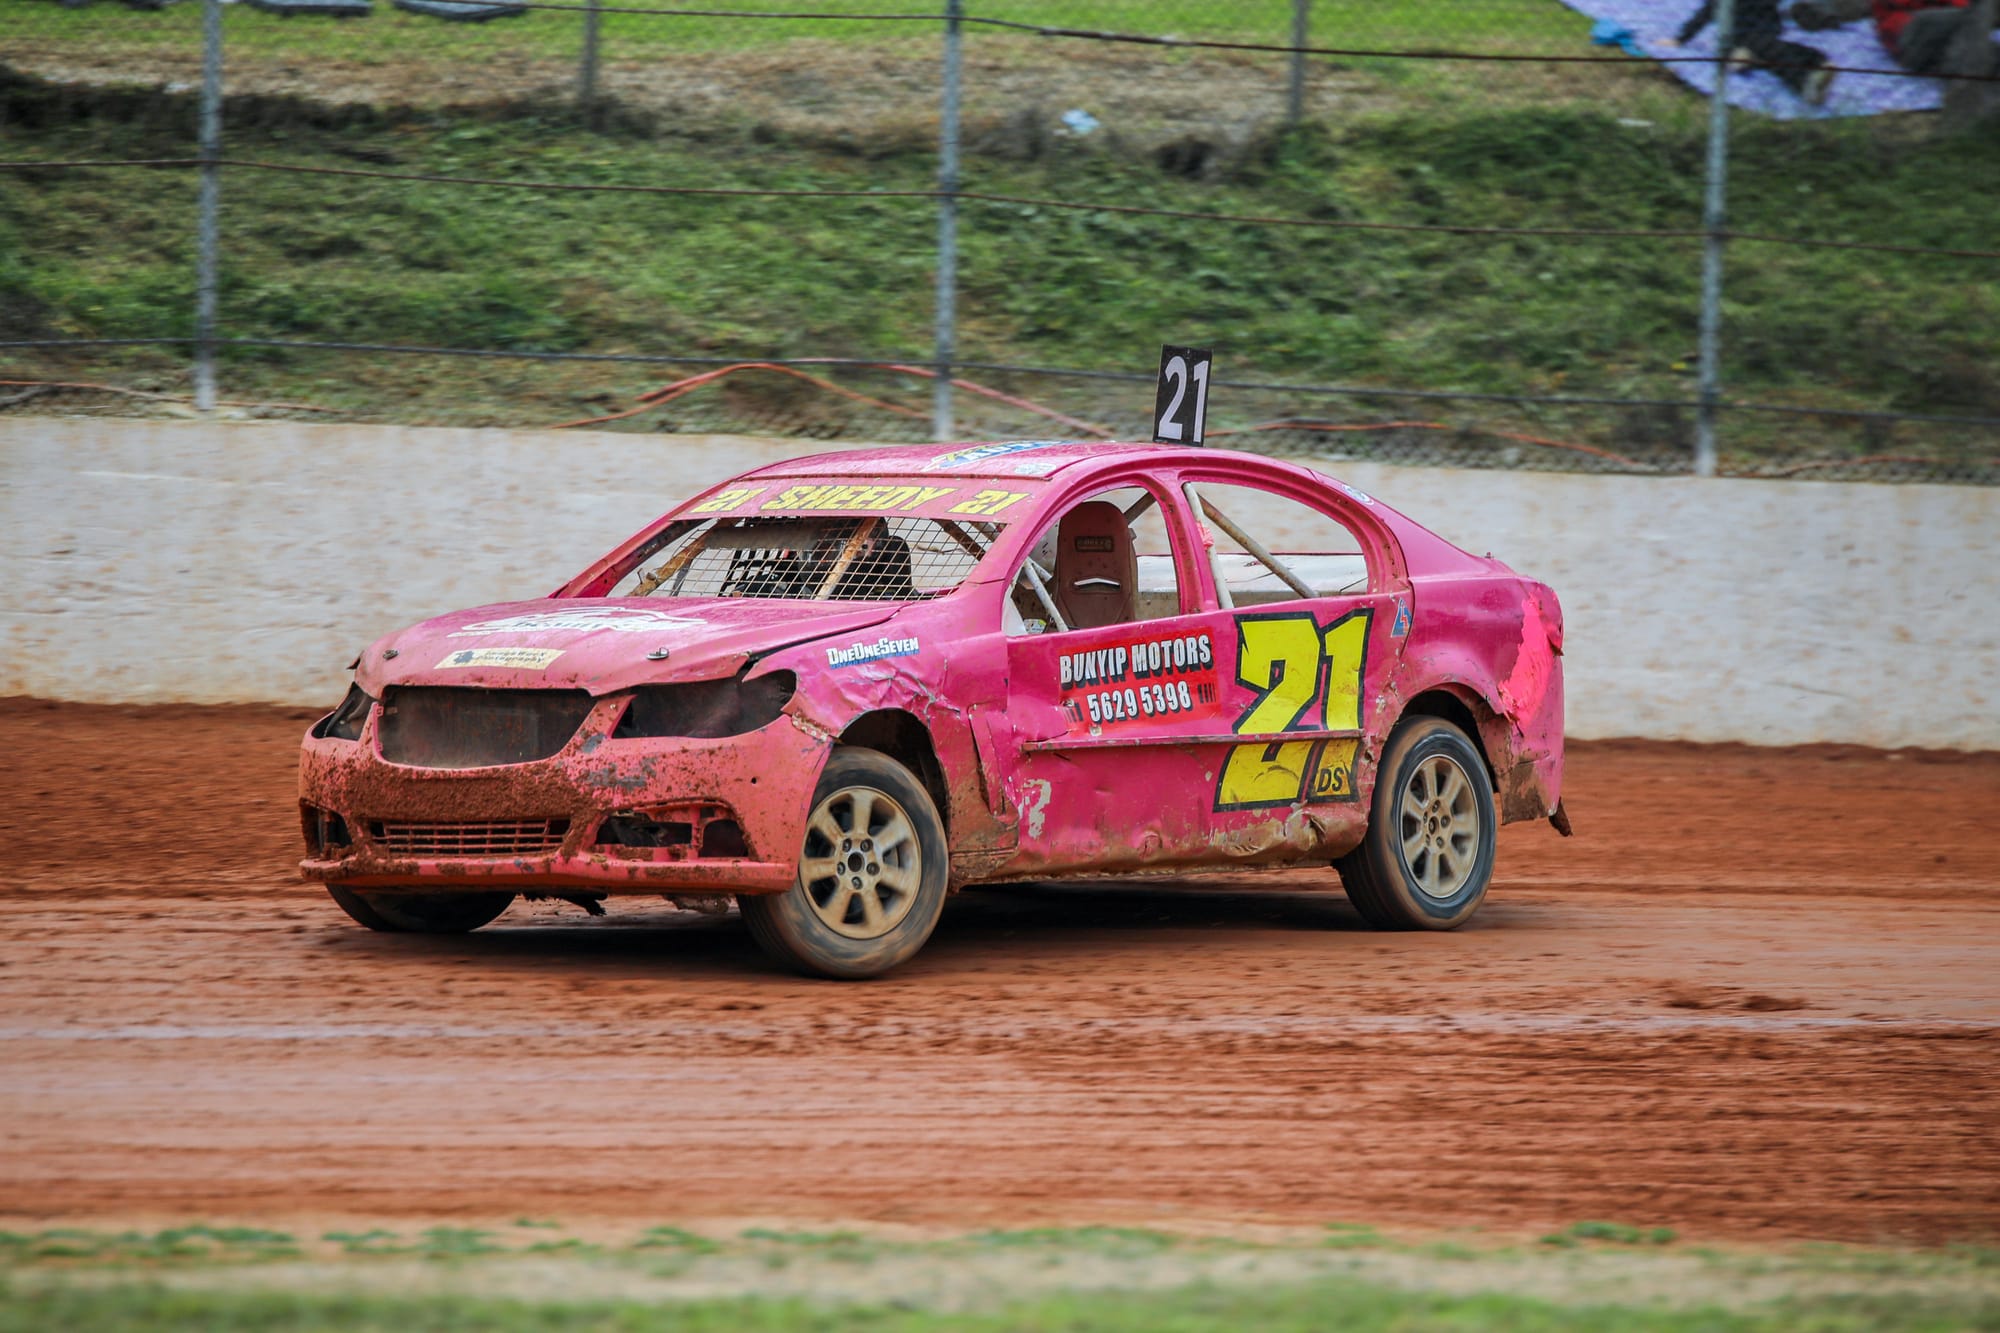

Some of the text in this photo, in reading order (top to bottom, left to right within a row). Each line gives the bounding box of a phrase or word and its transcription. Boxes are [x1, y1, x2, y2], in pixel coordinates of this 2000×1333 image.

[1158, 356, 1209, 443] 21
[691, 486, 1030, 514] 21 SHEEDY 21
[1059, 634, 1213, 687] BUNYIP MOTORS
[1087, 681, 1192, 723] 5629 5398
[1213, 608, 1375, 813] 21
[1316, 767, 1345, 793] DS
